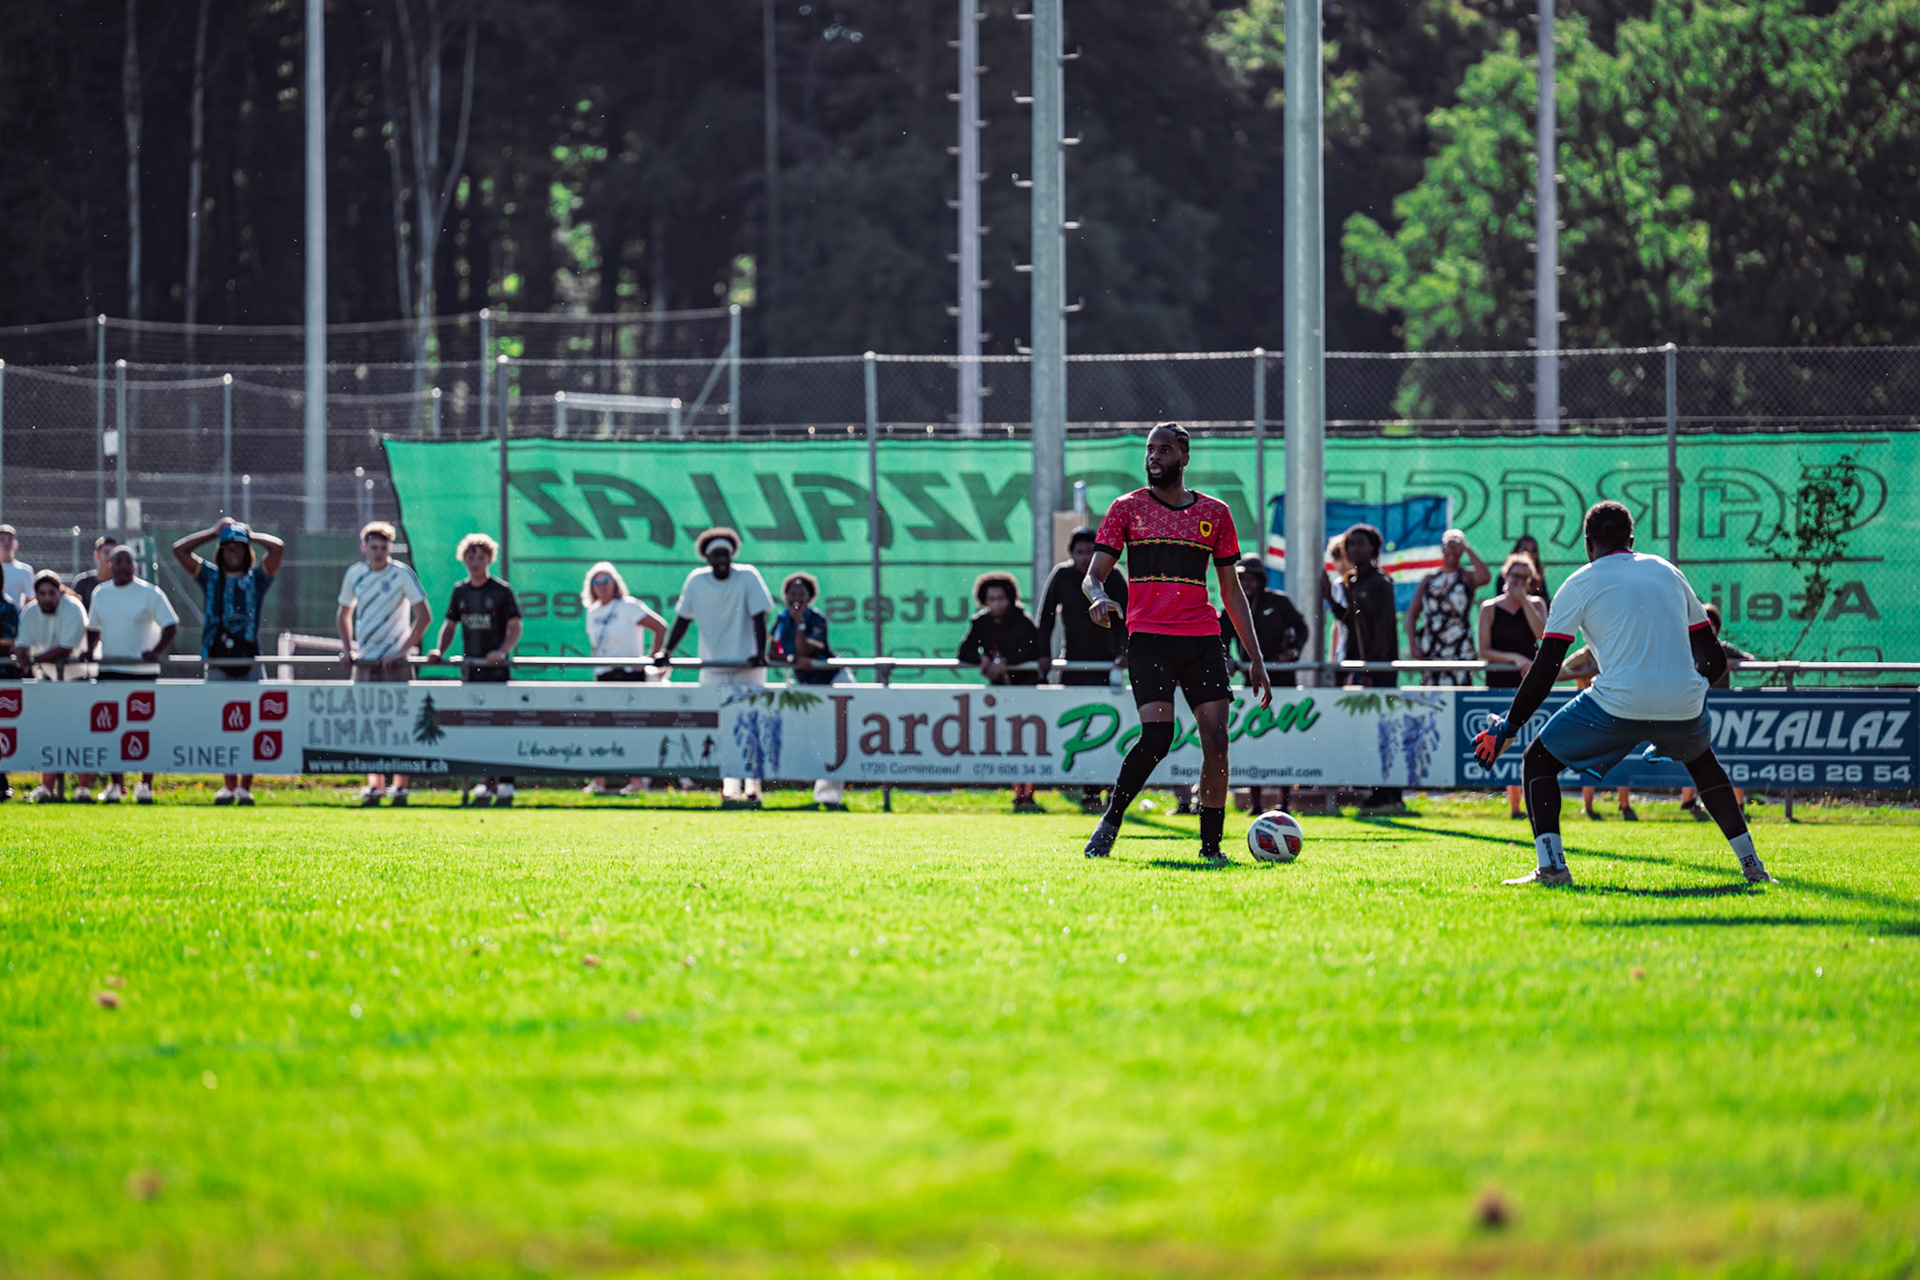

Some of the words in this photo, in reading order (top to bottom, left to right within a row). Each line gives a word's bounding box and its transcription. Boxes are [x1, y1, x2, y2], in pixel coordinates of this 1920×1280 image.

[308, 687, 409, 716] CLAUDE
[308, 717, 392, 746] LIMAT
[825, 692, 1052, 772] Jardin
[41, 746, 108, 767] SINEF
[173, 745, 240, 767] SINEF
[517, 740, 583, 763] L'énergie
[588, 740, 625, 757] verte
[308, 758, 449, 773] www.claudelimat.ch
[1826, 765, 1863, 782] 26
[1873, 765, 1911, 782] 54
